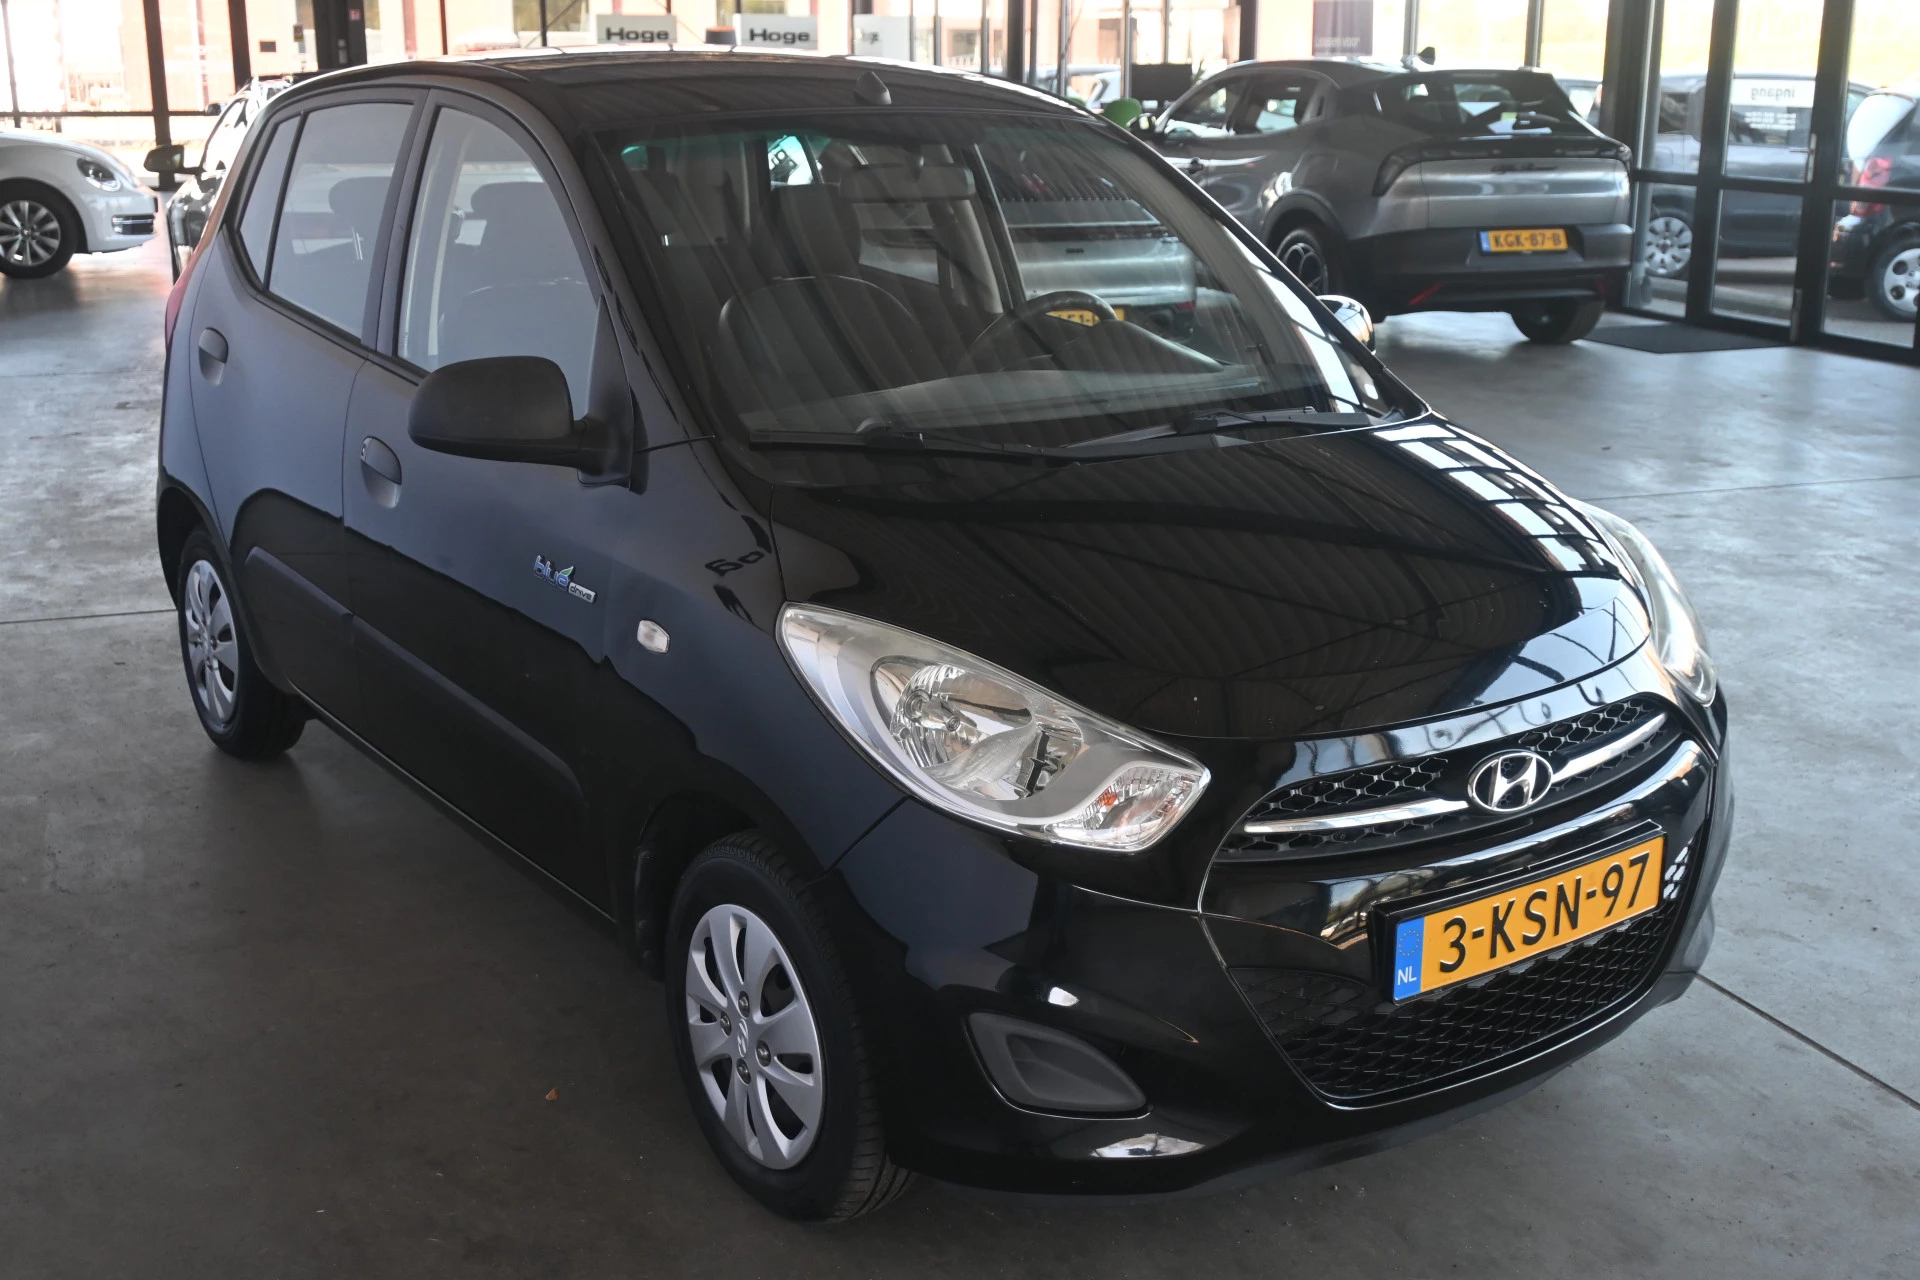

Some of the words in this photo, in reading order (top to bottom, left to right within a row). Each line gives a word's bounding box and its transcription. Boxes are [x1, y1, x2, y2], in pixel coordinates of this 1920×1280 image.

[606, 27, 669, 43] Hoge
[749, 28, 810, 44] Hoge
[569, 585, 593, 601] drive
[1439, 850, 1650, 974] 3-KSN-97
[1397, 965, 1417, 986] NL
